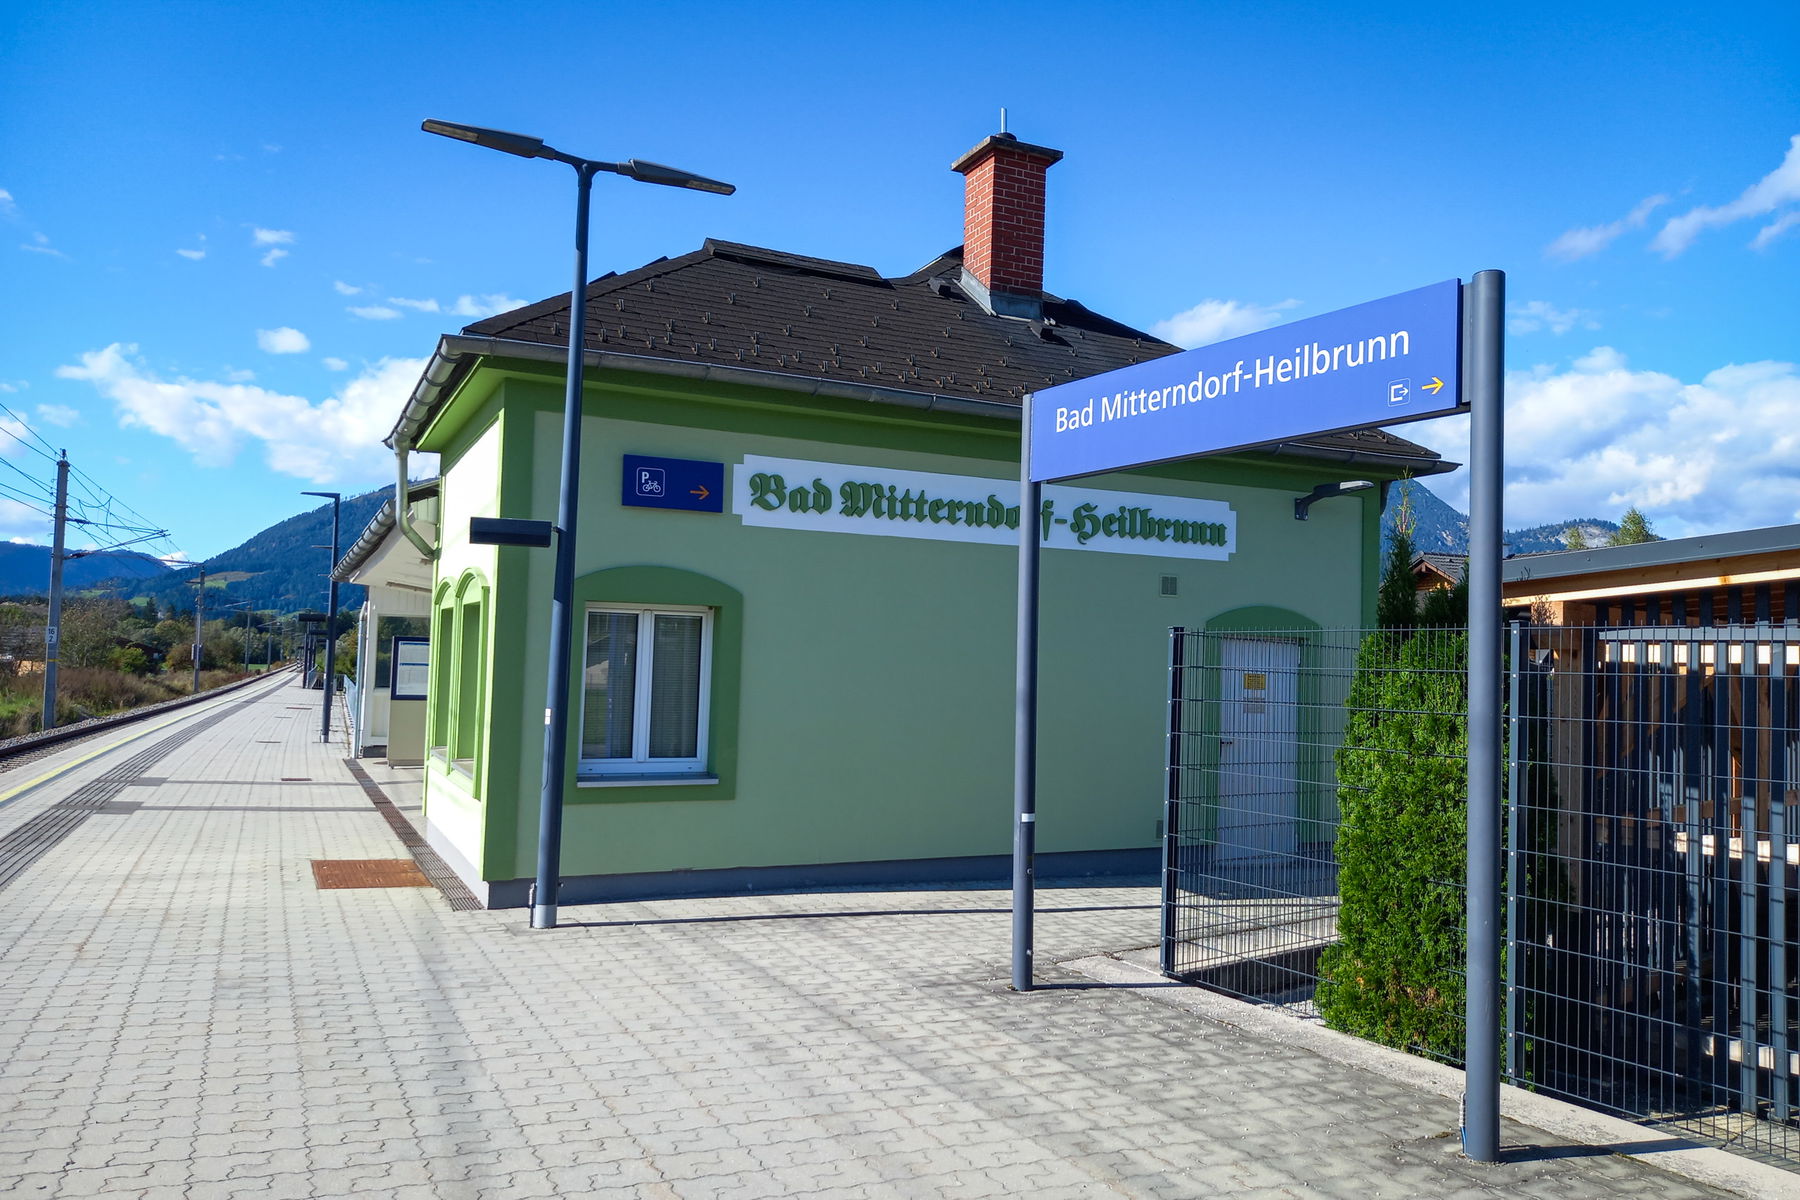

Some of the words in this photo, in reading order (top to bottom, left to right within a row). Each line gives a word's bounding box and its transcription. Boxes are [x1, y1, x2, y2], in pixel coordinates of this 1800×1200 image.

[1055, 398, 1094, 433] Bad
[1100, 330, 1409, 423] Mitterndorf-Heilbrunn
[641, 471, 650, 484] P
[749, 472, 833, 516] Bad
[839, 480, 1228, 547] Mitterndof-Heilbrunn
